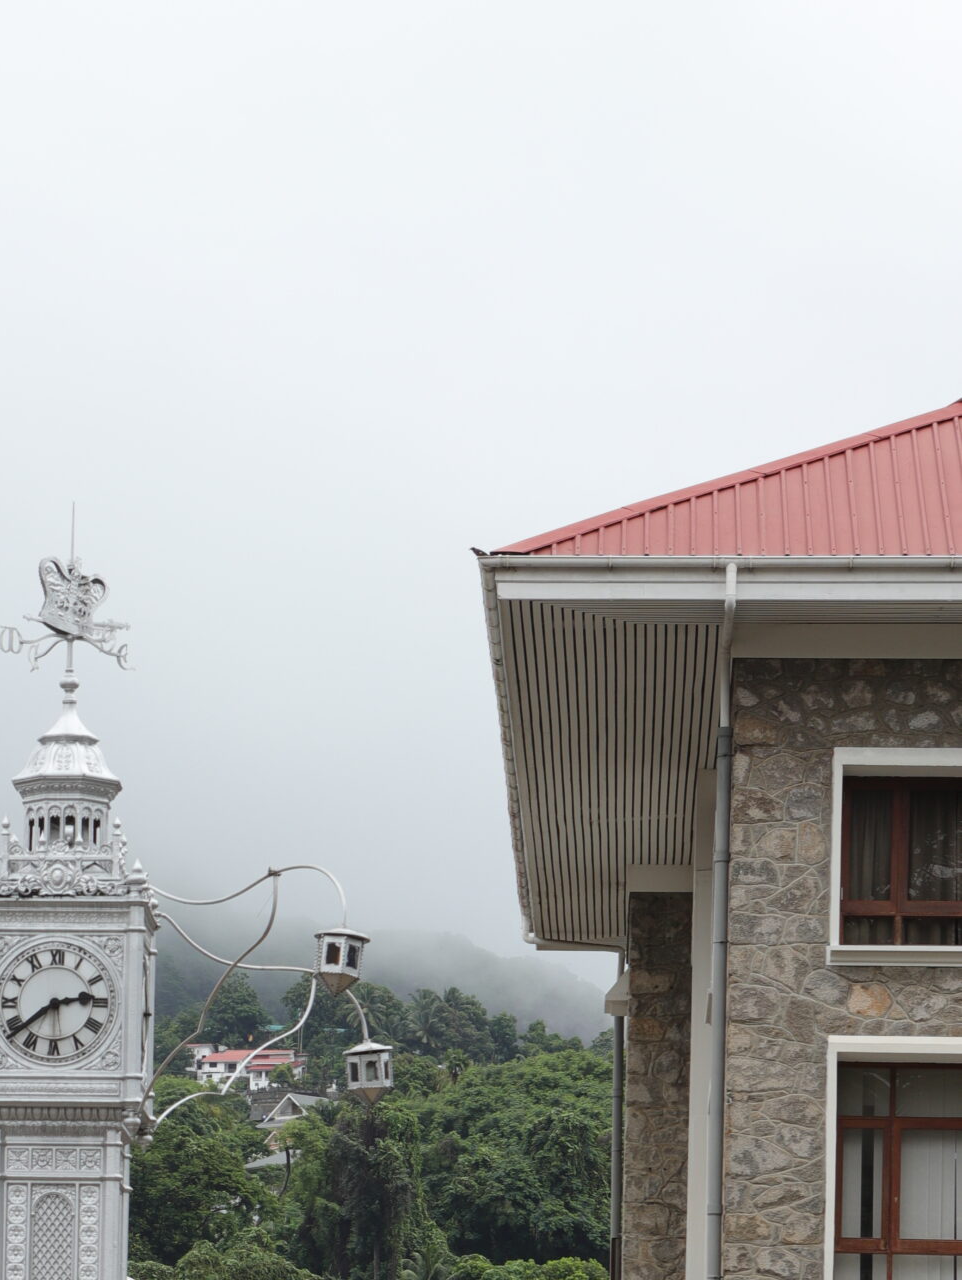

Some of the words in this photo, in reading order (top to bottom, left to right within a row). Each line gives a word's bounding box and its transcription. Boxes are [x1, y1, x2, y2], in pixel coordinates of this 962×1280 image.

[26, 953, 42, 973] XI
[50, 950, 65, 966] XII
[11, 974, 25, 987] X
[87, 974, 104, 986] II
[1, 996, 18, 1009] IX
[91, 997, 108, 1009] III
[22, 1032, 38, 1051] VII
